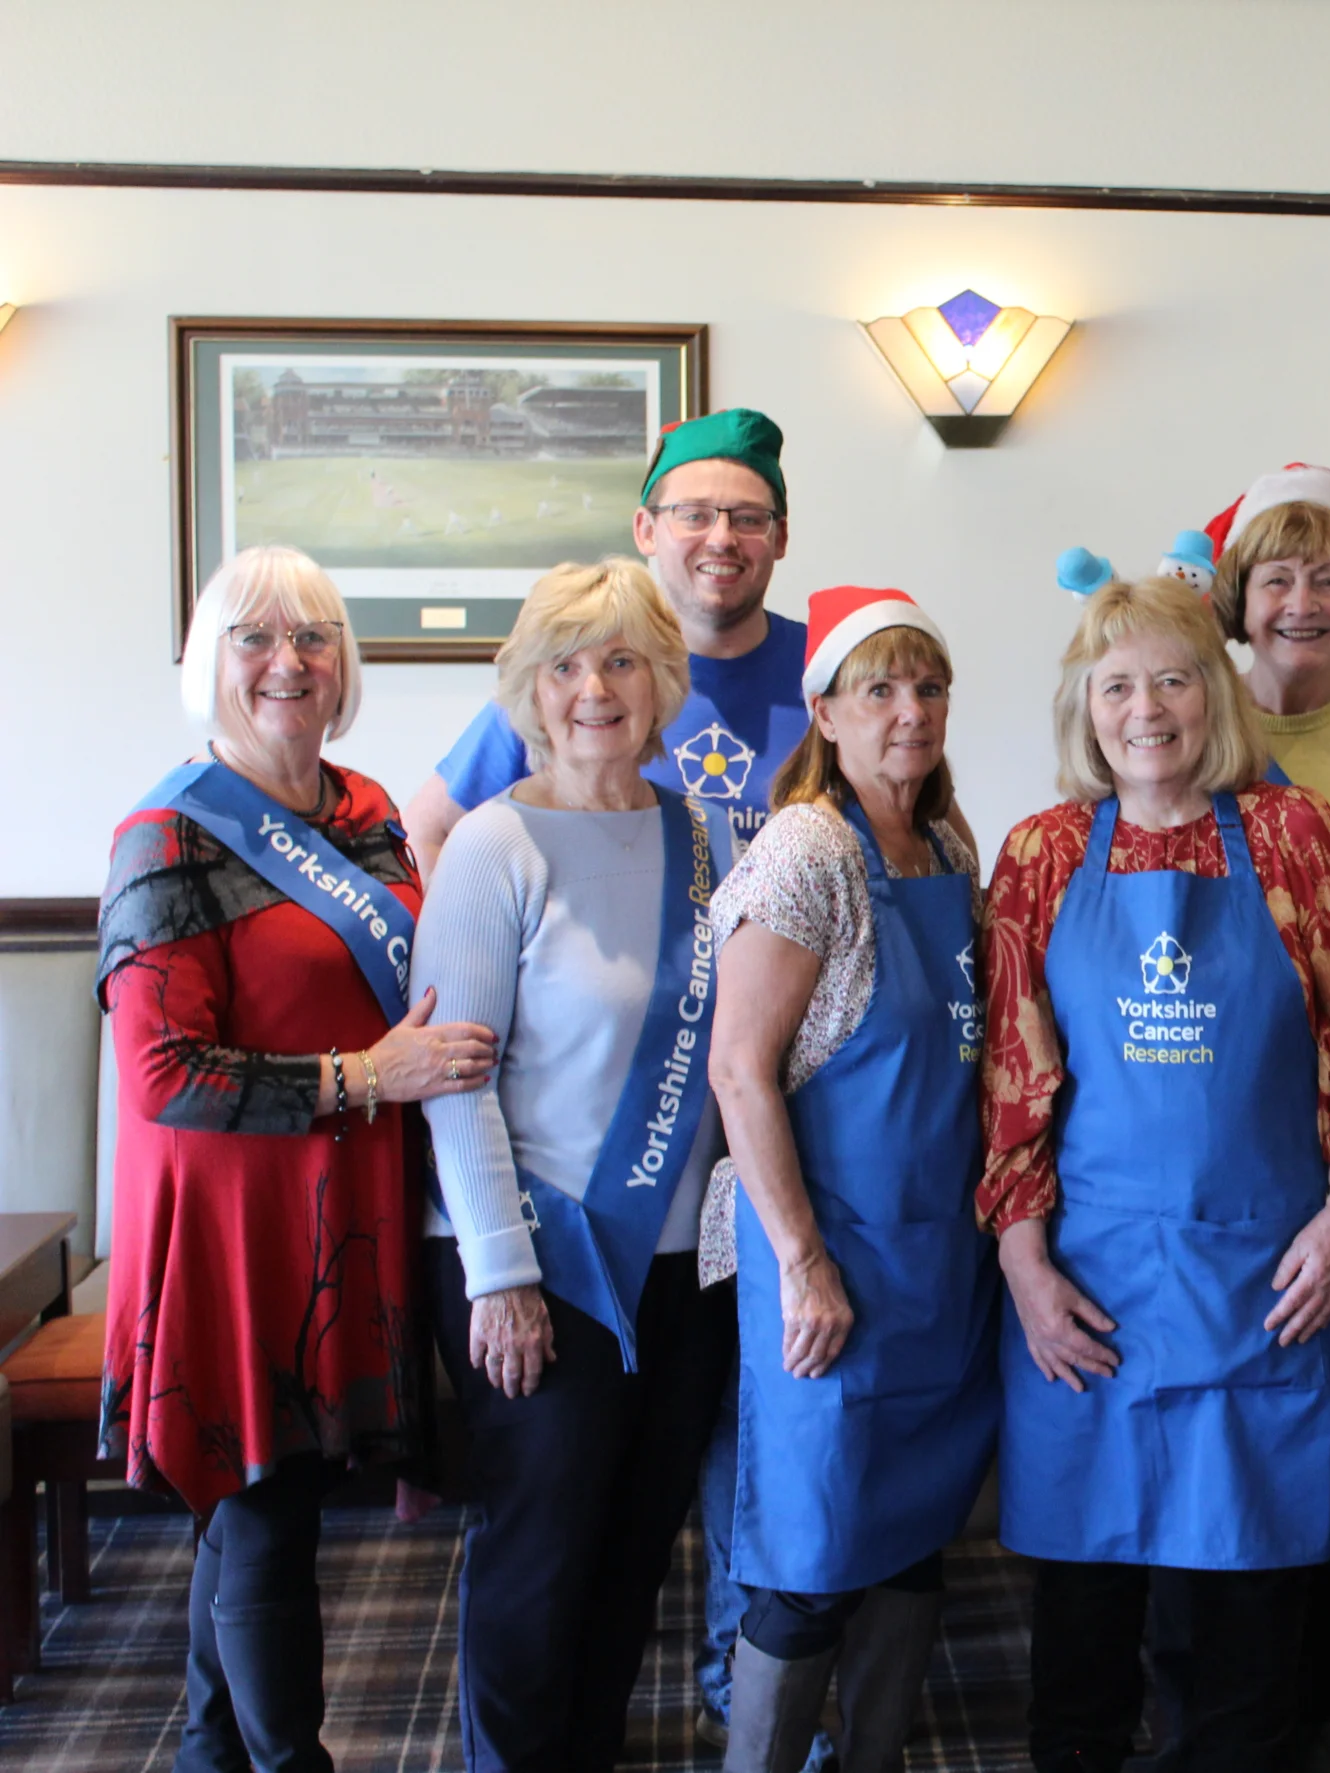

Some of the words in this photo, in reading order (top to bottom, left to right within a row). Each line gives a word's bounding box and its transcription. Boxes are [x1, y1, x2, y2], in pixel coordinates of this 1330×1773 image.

[258, 813, 388, 941] Yorkshire
[1116, 997, 1217, 1019] Yorkshire
[1128, 1020, 1204, 1041] Cancer
[626, 1028, 697, 1188] Yorkshire
[678, 908, 713, 1023] Cancer
[1123, 1042, 1214, 1064] Research
